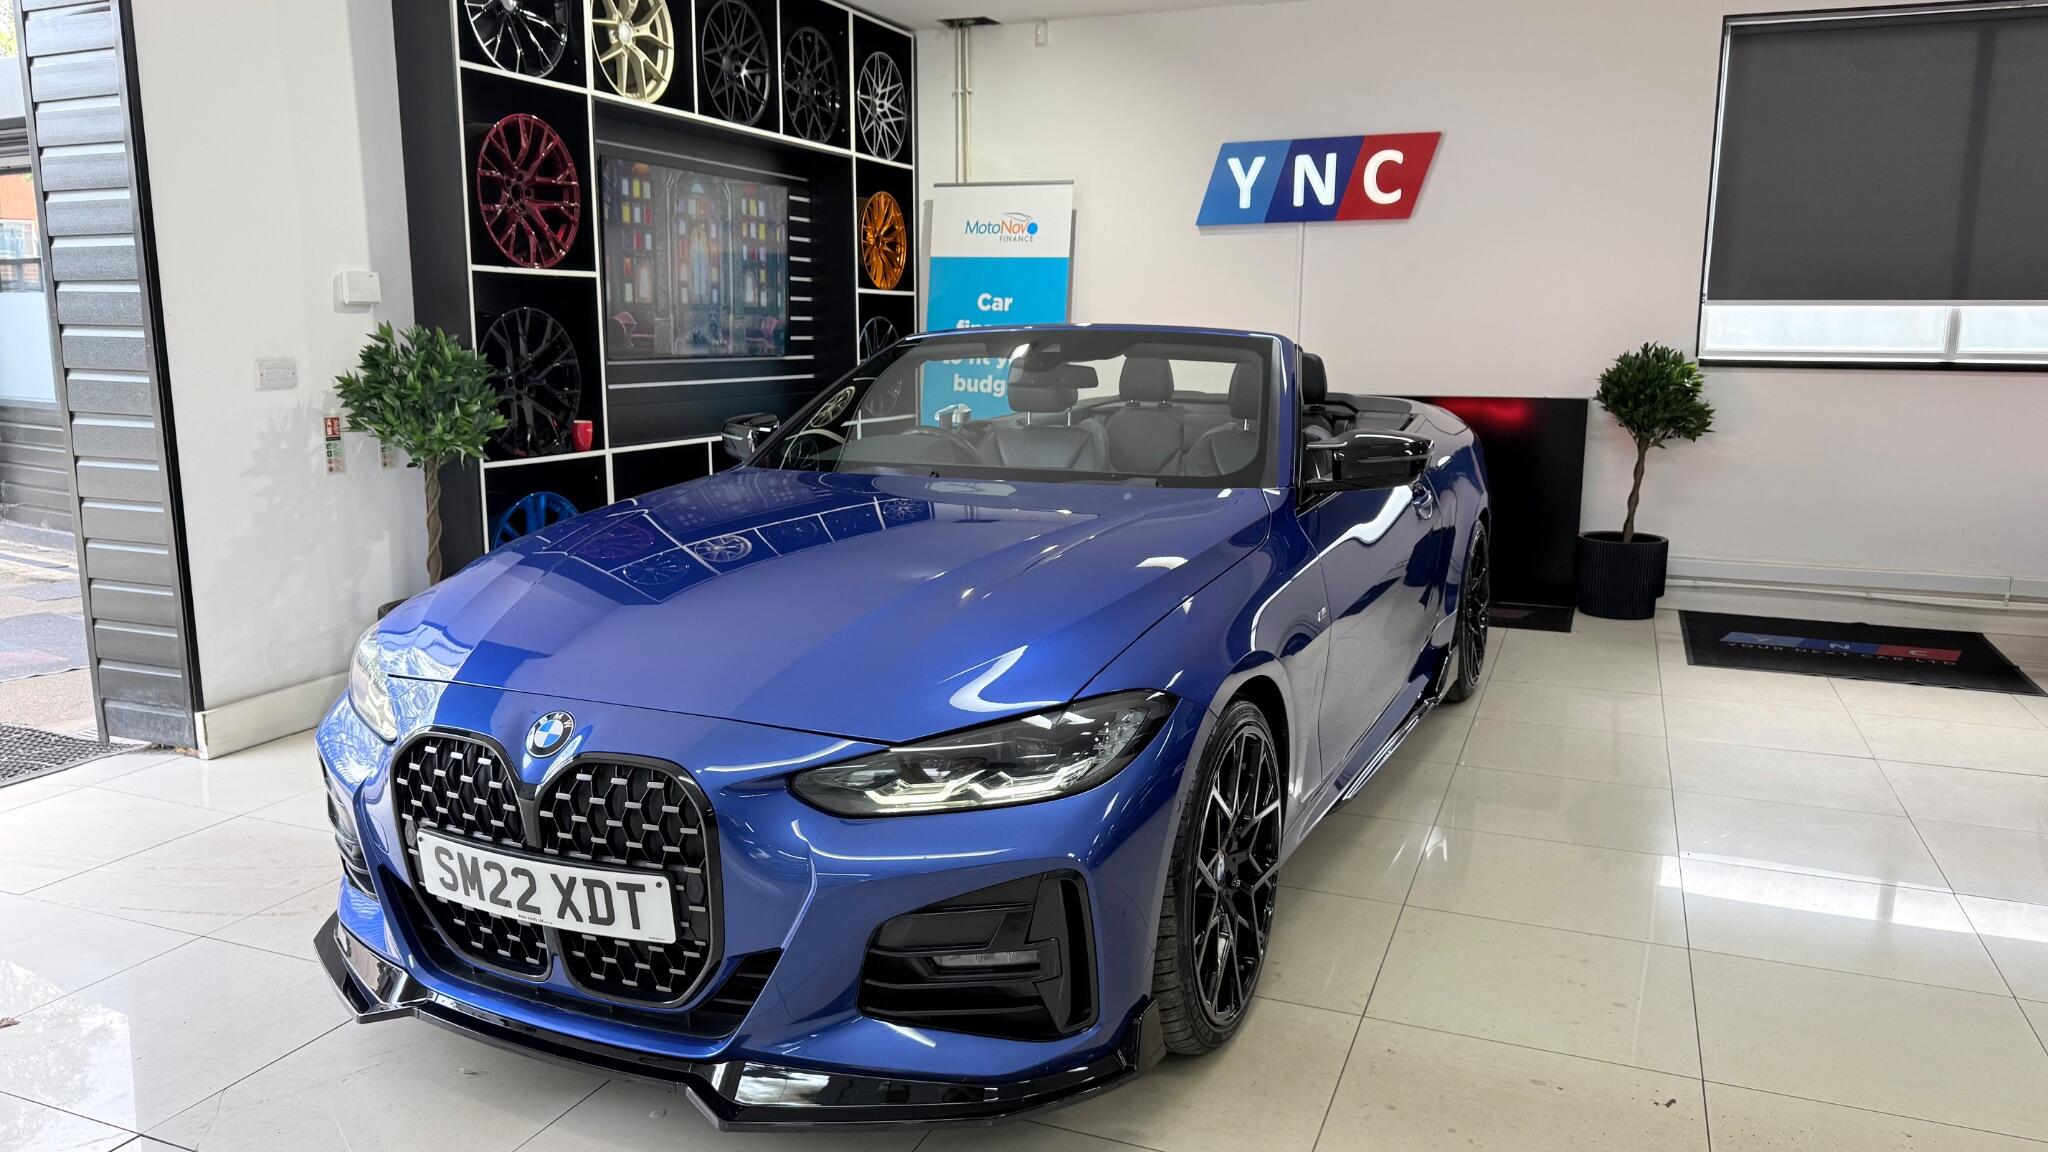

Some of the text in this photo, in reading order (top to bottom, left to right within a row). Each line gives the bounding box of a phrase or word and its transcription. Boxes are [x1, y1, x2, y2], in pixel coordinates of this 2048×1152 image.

[1227, 149, 1404, 209] YNC
[999, 235, 1034, 243] FINANCE
[976, 292, 1014, 312] Car
[953, 373, 1007, 398] budg
[435, 846, 646, 931] SM22 XDT
